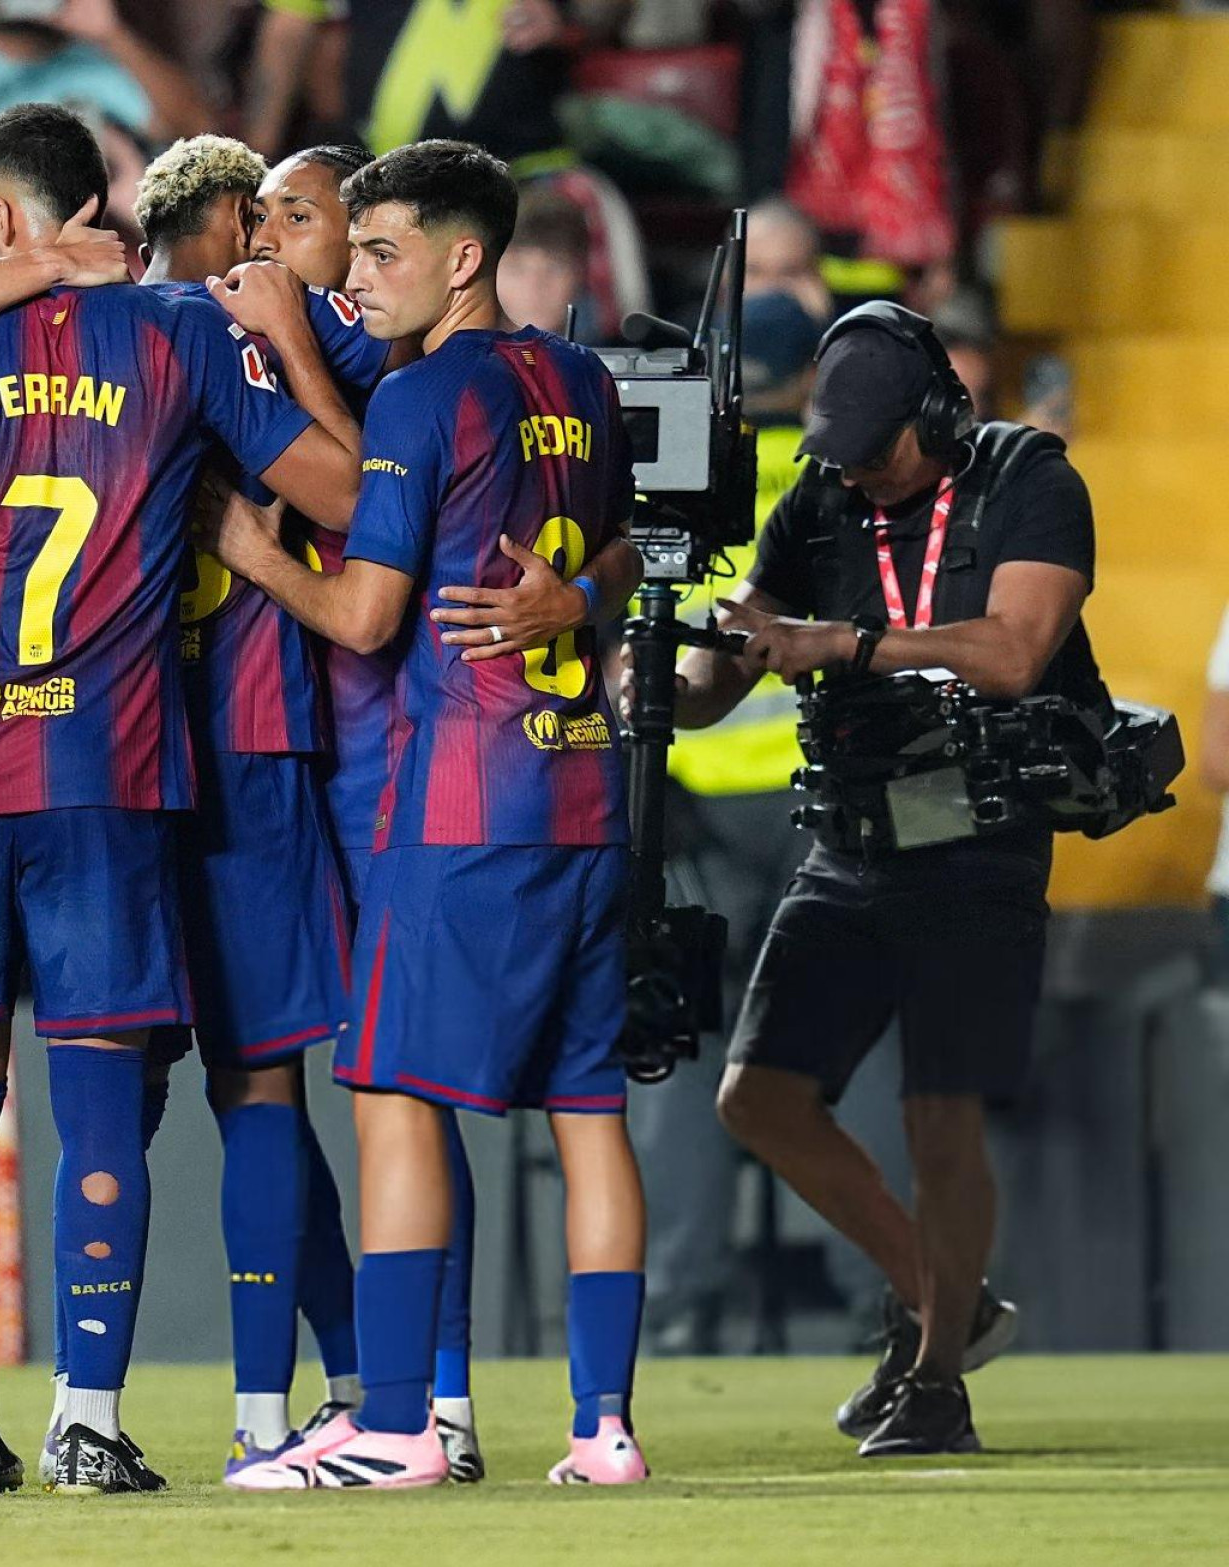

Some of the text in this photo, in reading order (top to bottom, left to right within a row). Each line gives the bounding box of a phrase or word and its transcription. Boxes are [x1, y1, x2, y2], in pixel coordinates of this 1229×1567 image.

[518, 415, 592, 463] PEDRI
[0, 474, 99, 666] 7
[71, 1280, 132, 1296] BARÇA
